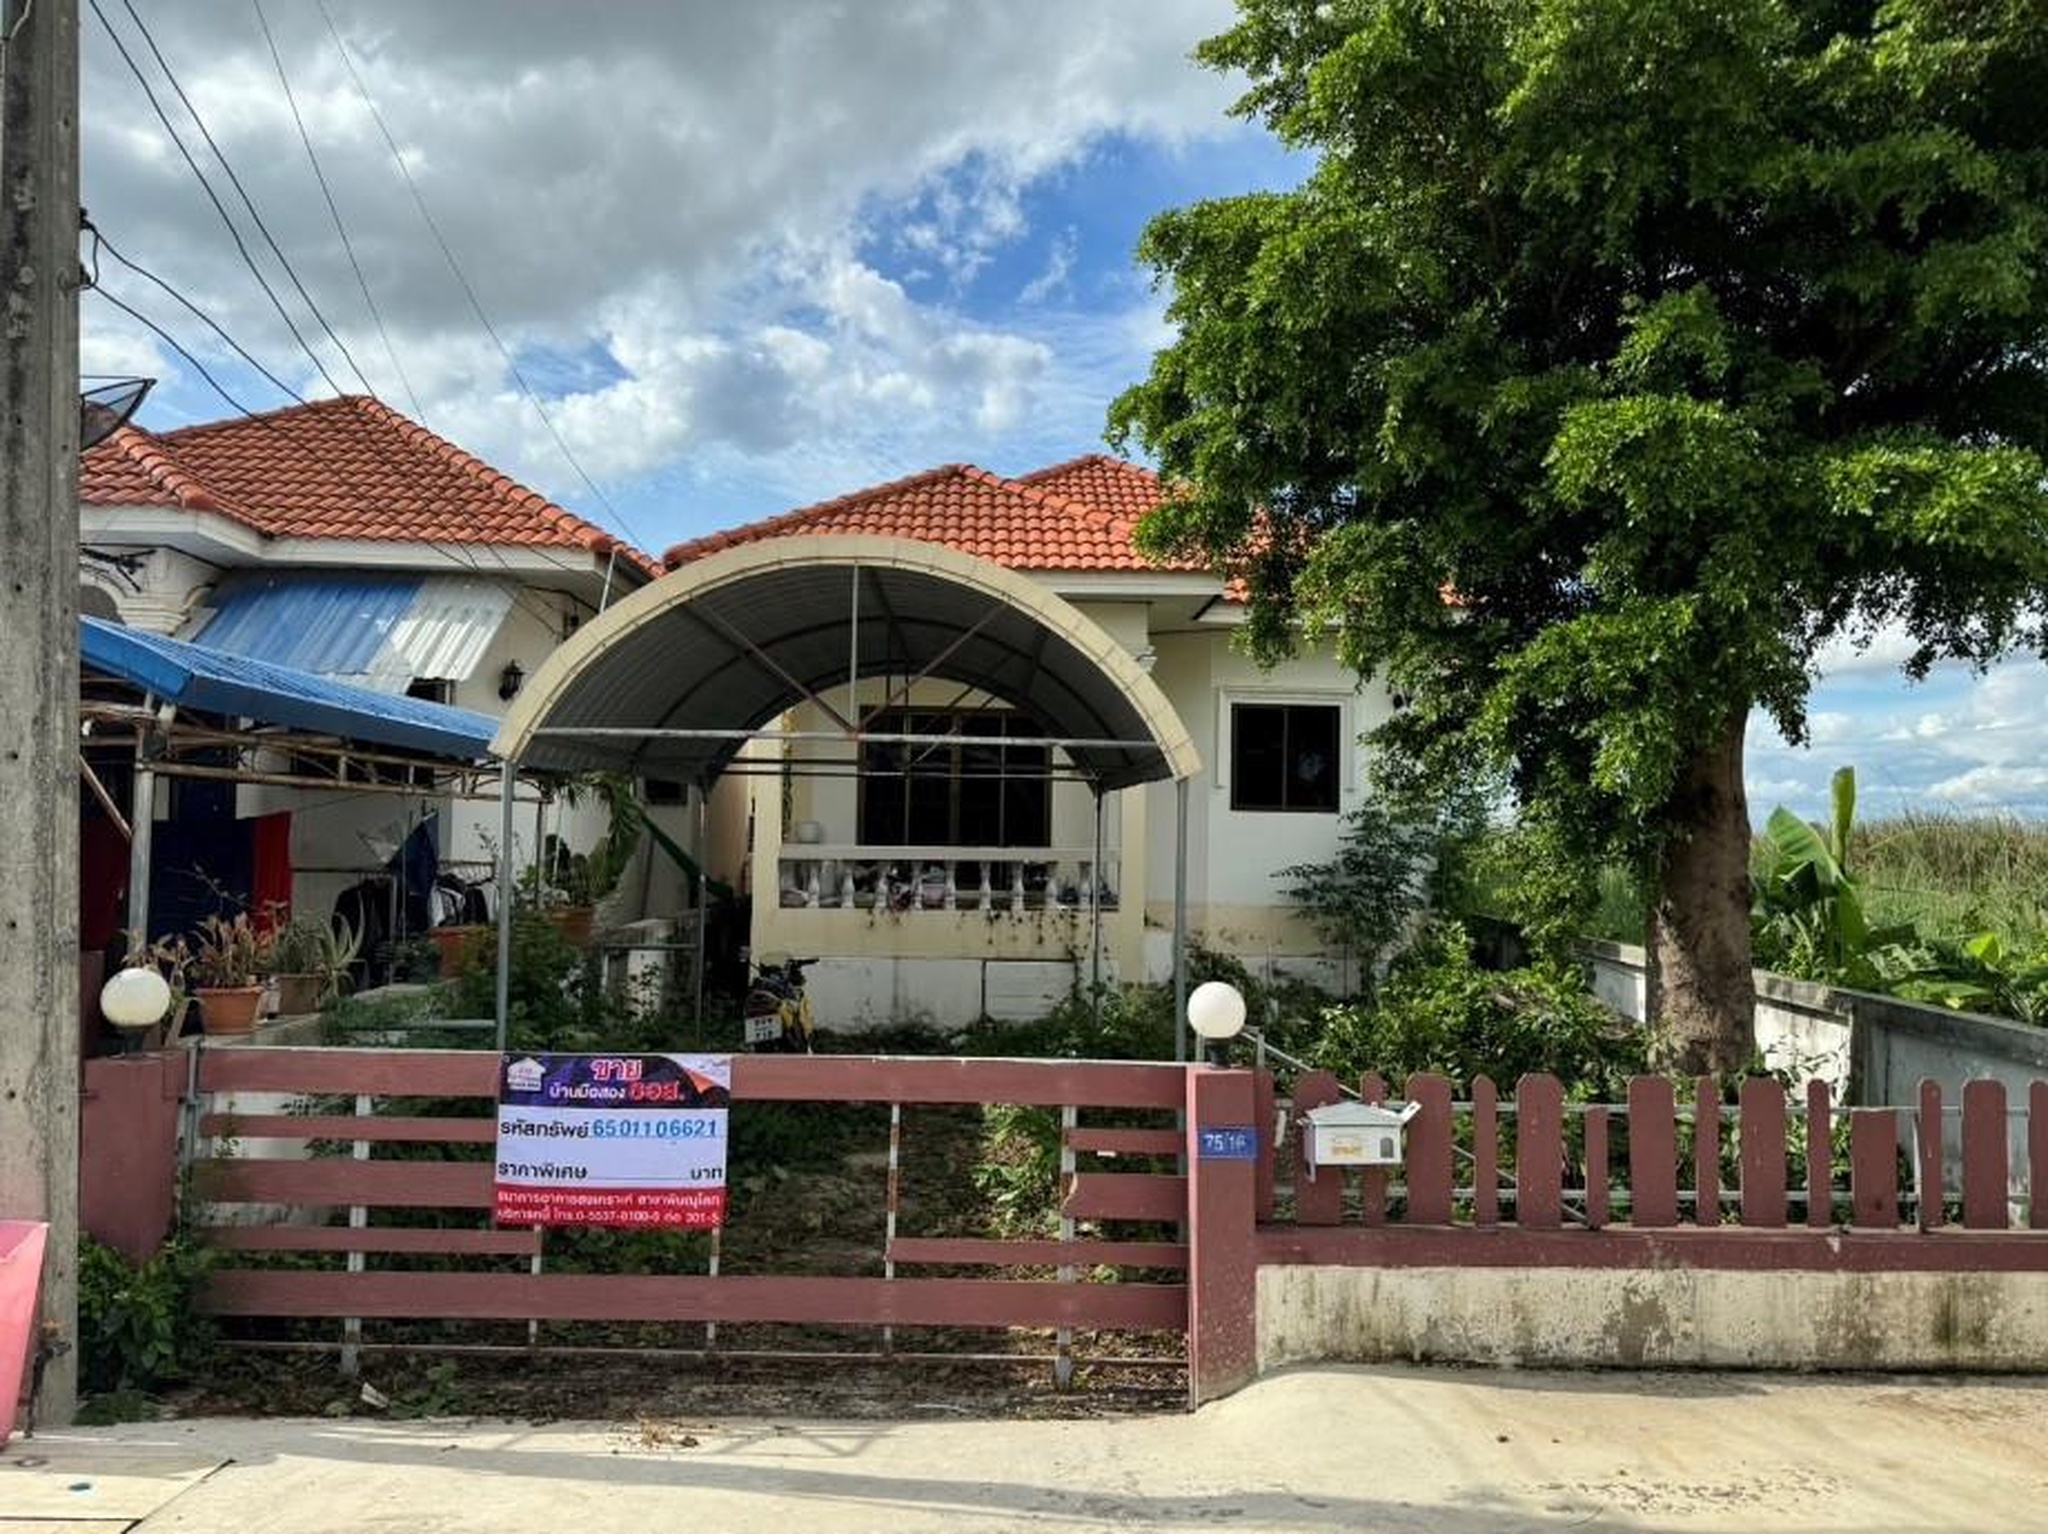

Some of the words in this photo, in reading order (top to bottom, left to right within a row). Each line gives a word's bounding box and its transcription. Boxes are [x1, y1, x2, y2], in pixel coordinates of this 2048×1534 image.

[590, 1059, 642, 1081] ขาย
[500, 1118, 590, 1138] รหัสทรัพย์
[593, 1118, 717, 1138] 6501106621
[498, 1161, 588, 1180] ราคาพิเศษ
[690, 1166, 723, 1180] บาท
